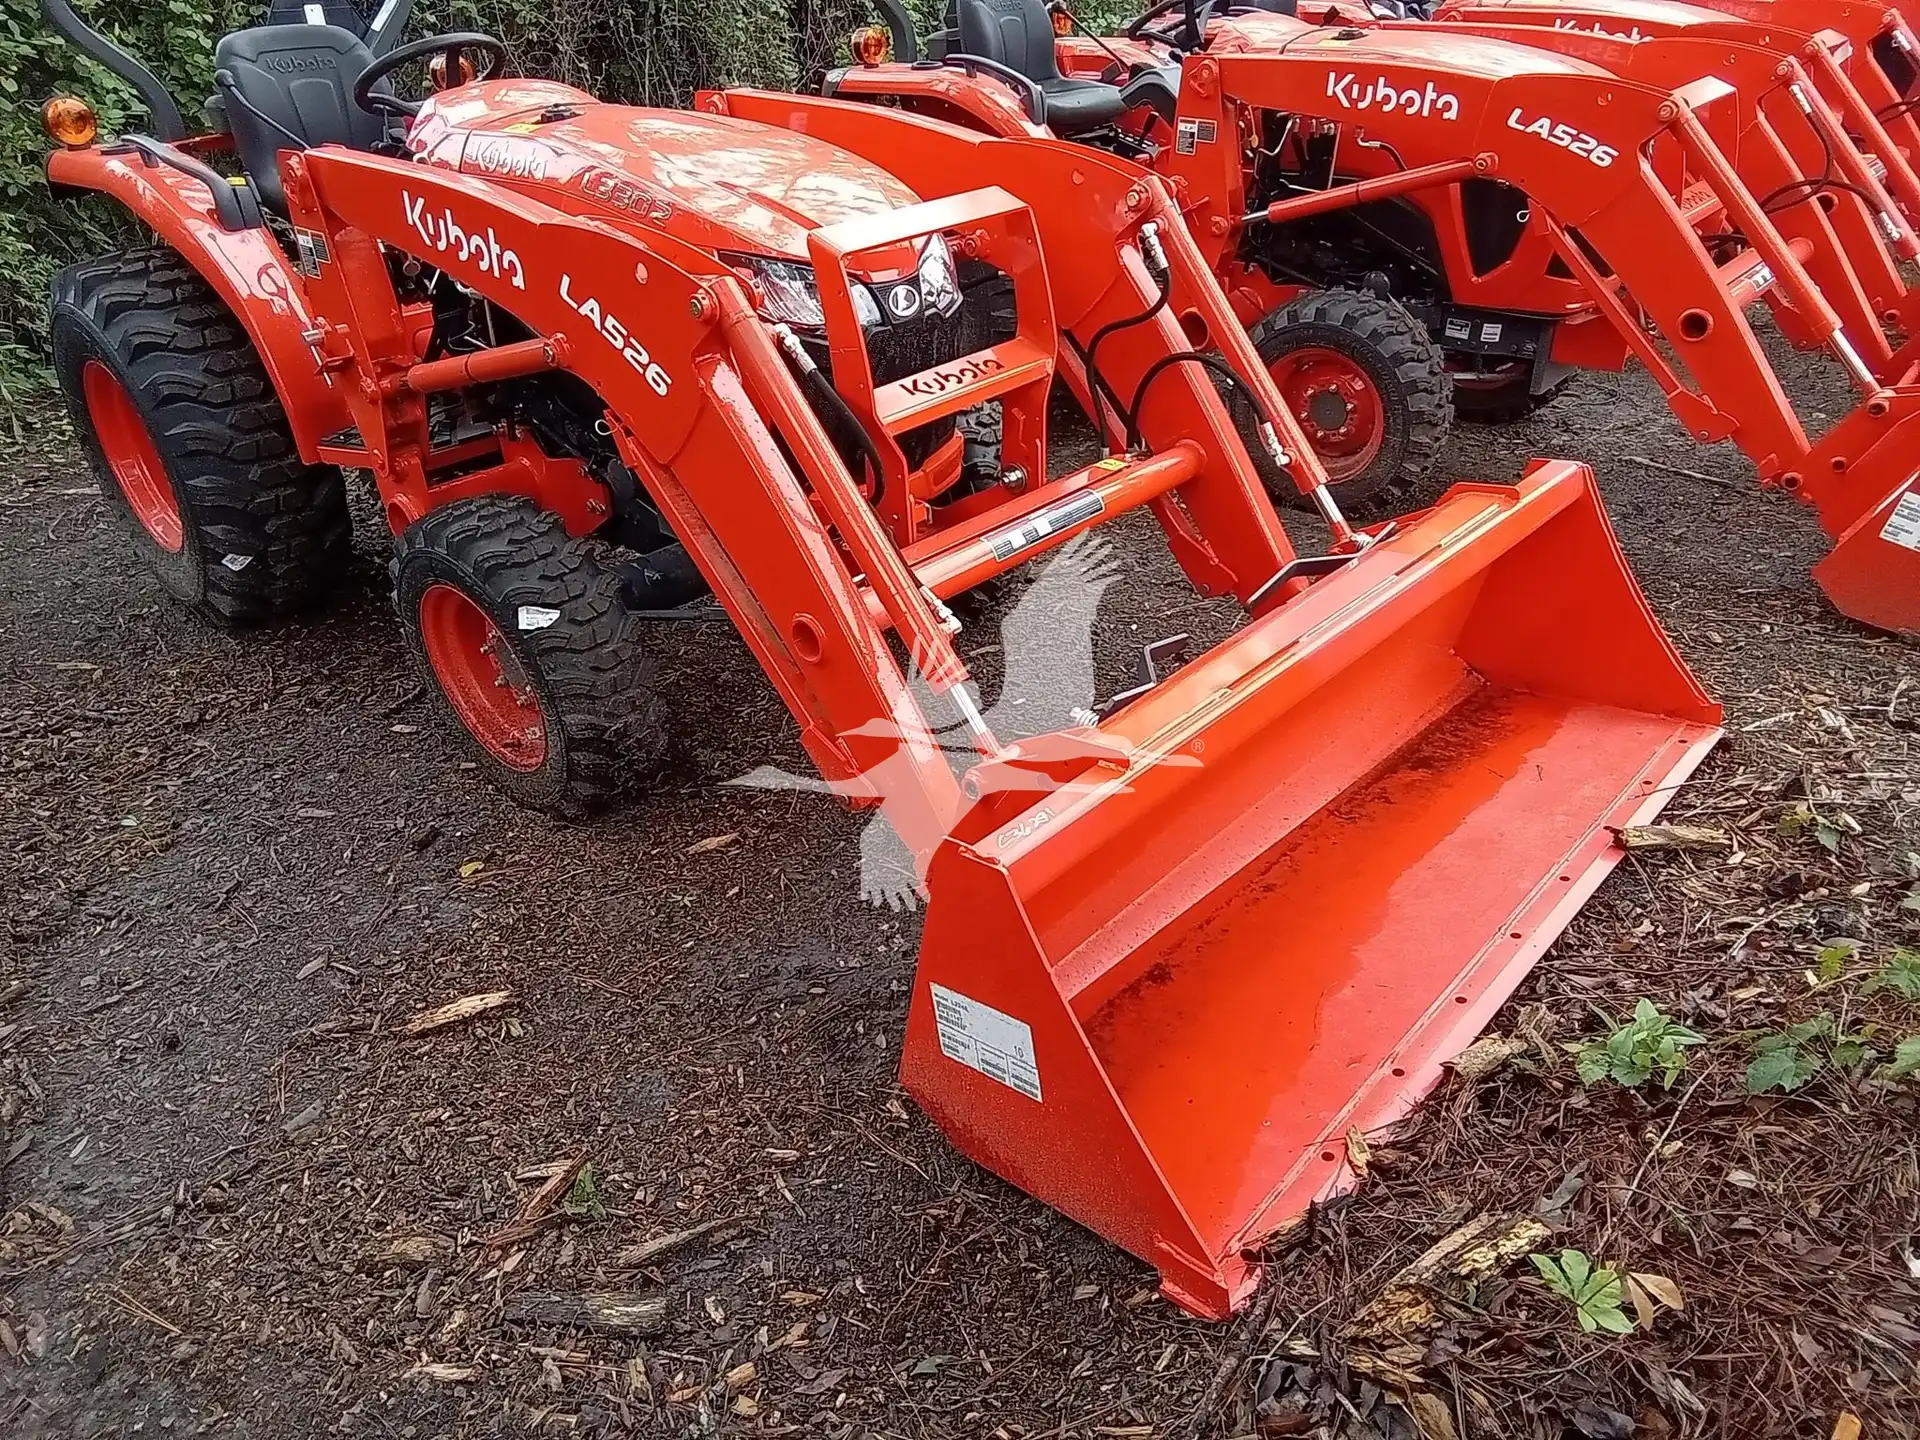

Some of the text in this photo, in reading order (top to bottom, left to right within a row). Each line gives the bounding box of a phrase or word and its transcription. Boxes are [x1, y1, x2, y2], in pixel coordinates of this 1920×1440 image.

[1554, 18, 1656, 41] Kbt
[266, 54, 336, 74] Kubota
[1326, 71, 1460, 121] Kubota
[472, 140, 548, 181] Kubota
[1506, 108, 1619, 168] LA526
[402, 190, 526, 290] Kubota
[559, 273, 673, 397] LA526
[899, 359, 1005, 396] Kubota
